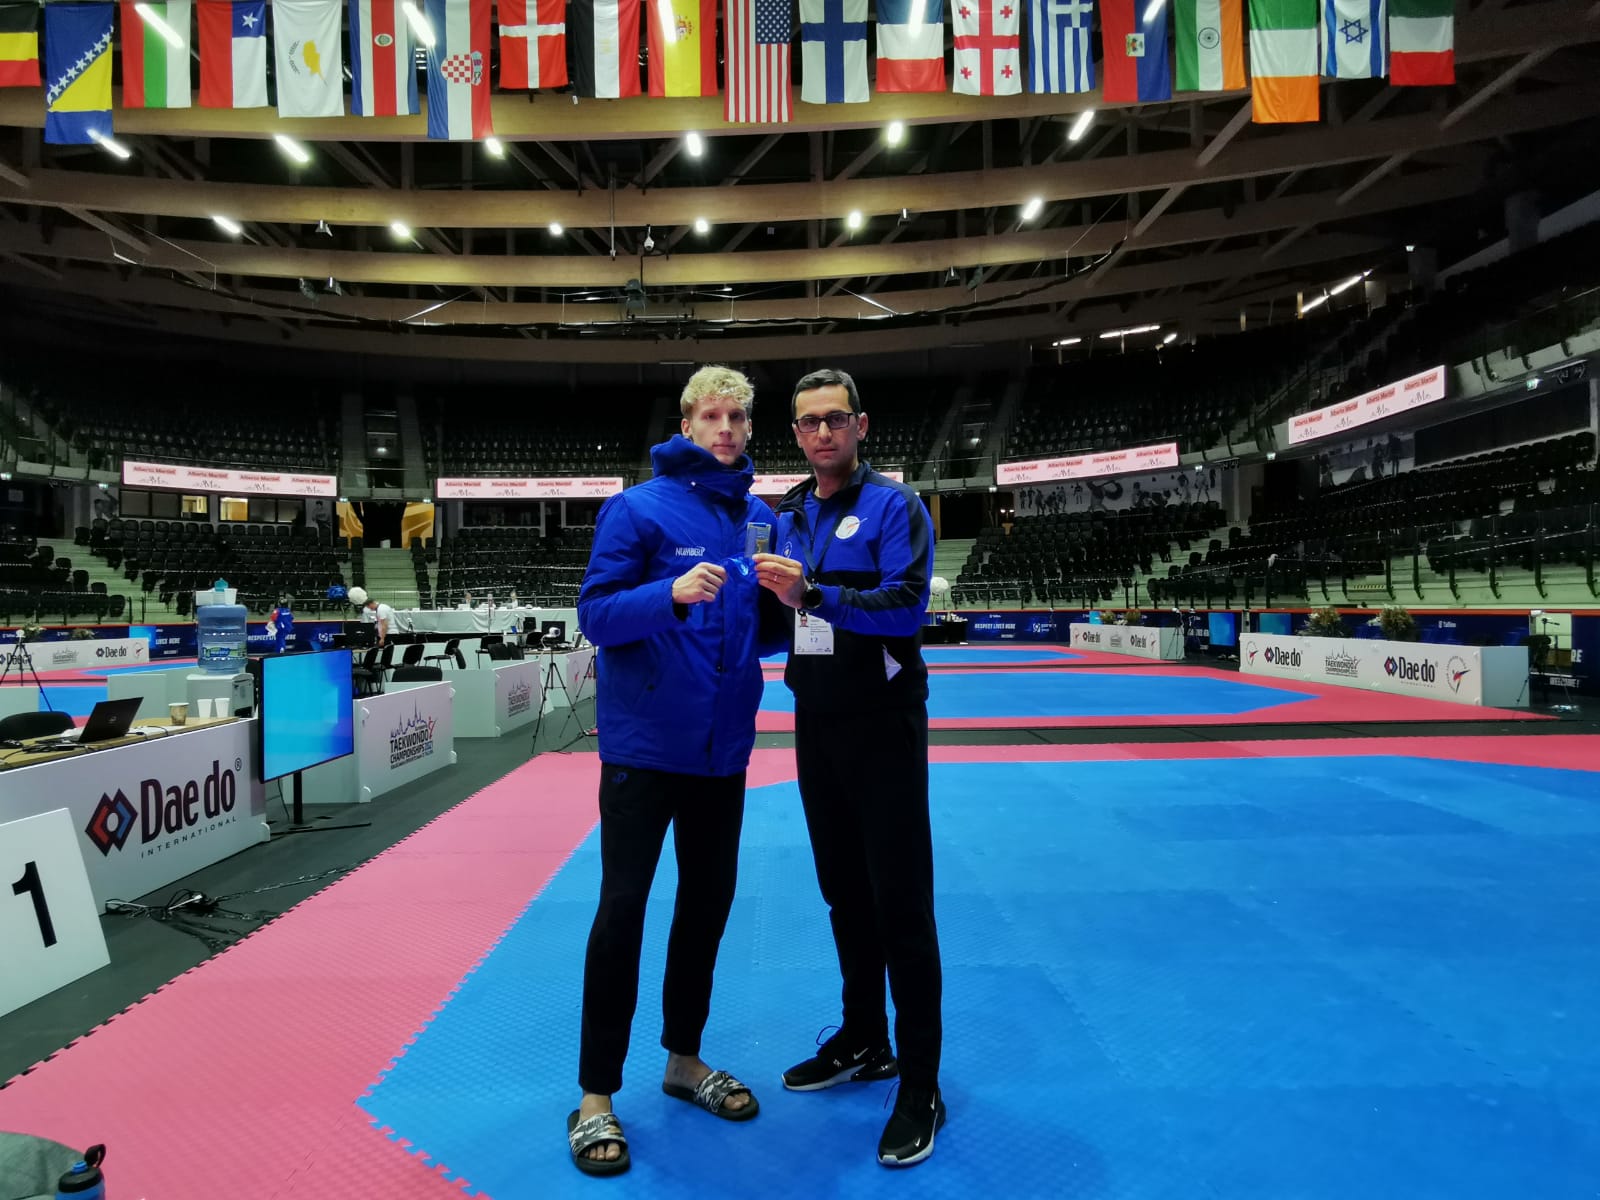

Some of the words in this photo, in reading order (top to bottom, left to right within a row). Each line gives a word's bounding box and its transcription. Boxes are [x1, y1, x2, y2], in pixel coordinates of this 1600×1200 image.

[105, 646, 127, 657] Daedo
[1275, 647, 1300, 667] Daedo
[1399, 657, 1435, 682] Daedo
[390, 729, 428, 753] TAEKWONDO
[391, 744, 424, 763] CHAMPIONSHIPS
[140, 760, 235, 844] Daedo
[141, 816, 236, 858] INTERNATIONAL
[12, 860, 57, 948] 1
